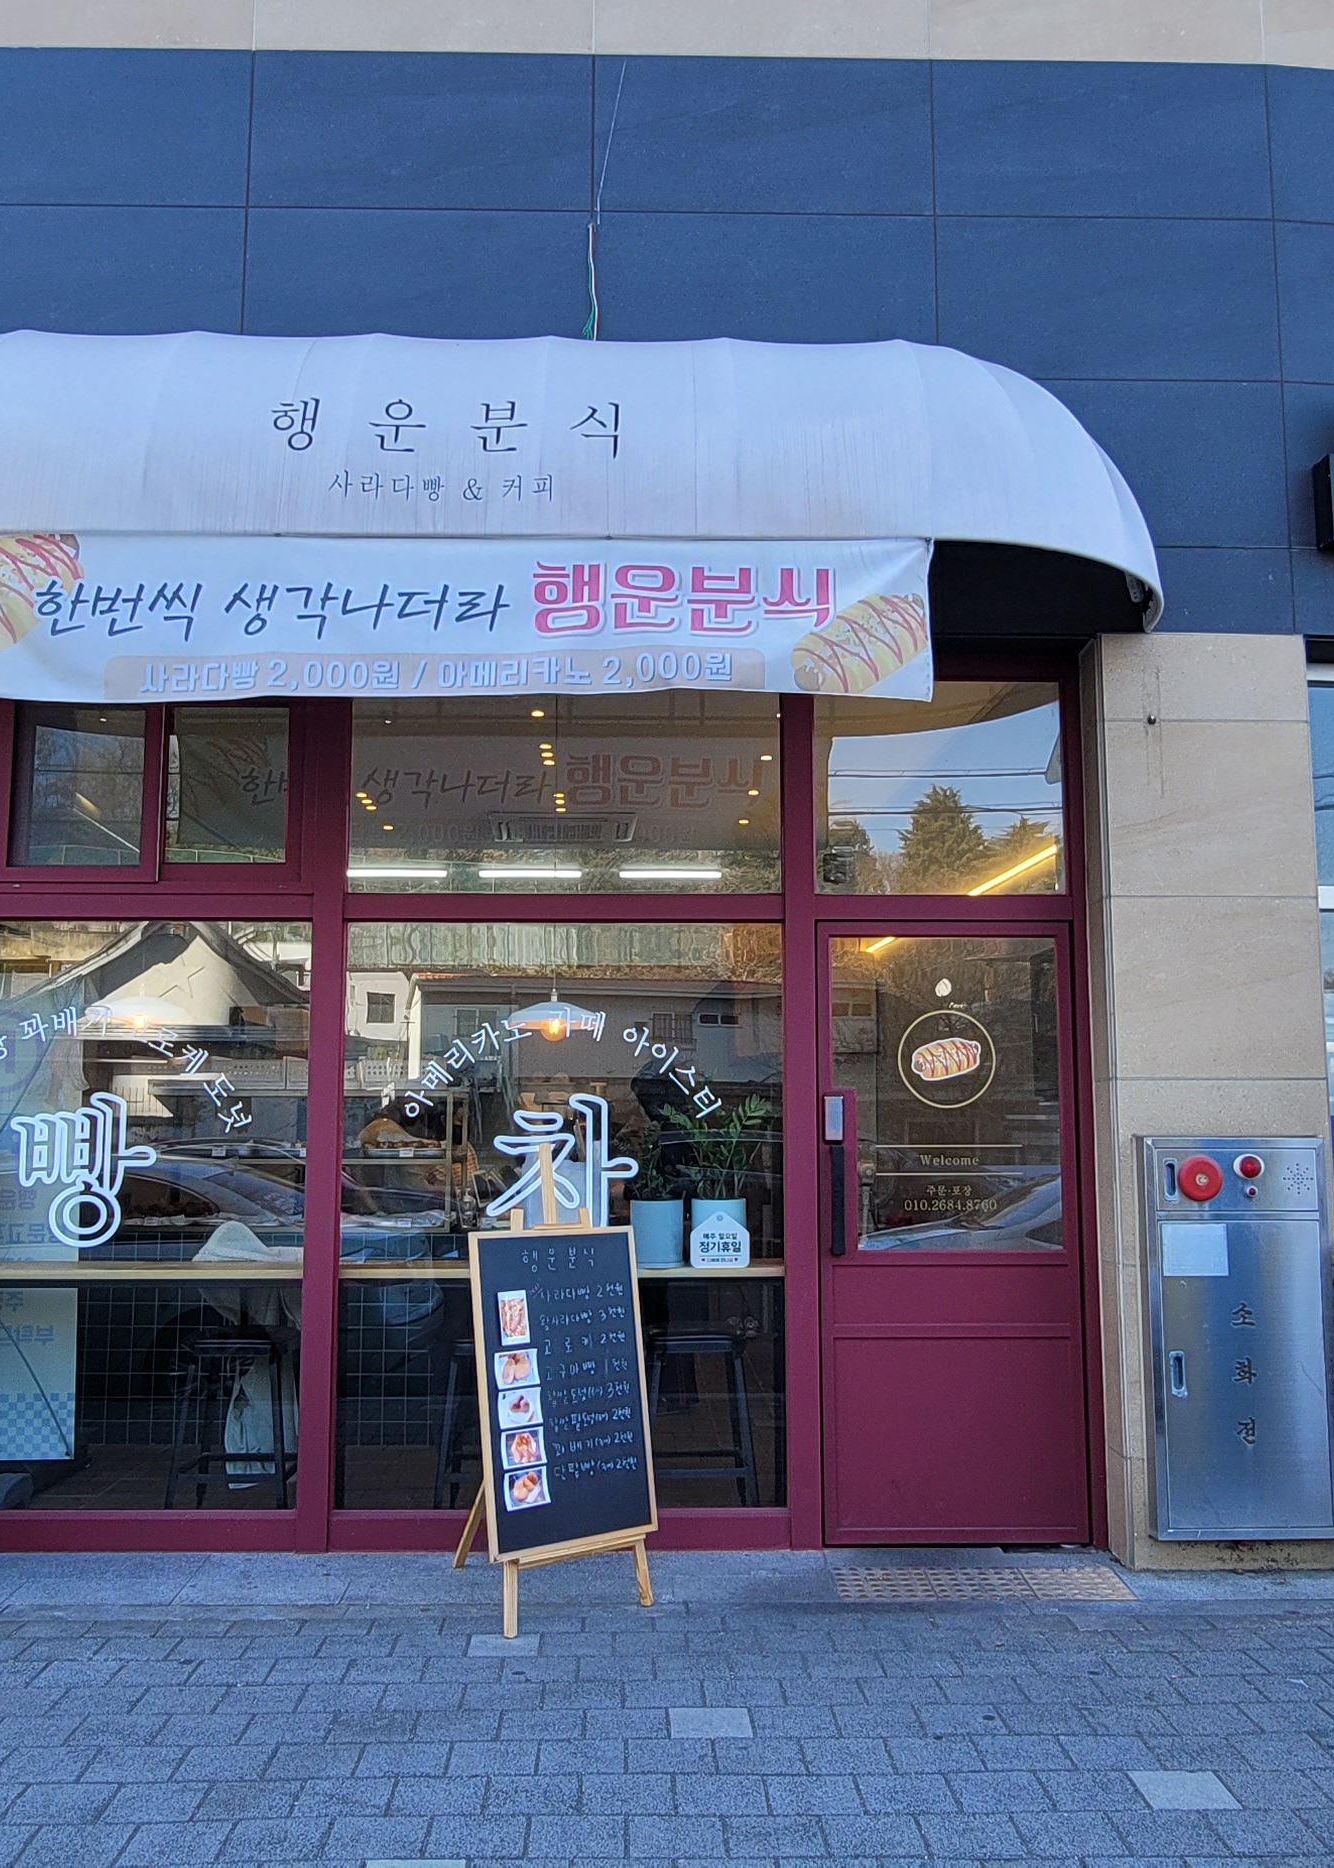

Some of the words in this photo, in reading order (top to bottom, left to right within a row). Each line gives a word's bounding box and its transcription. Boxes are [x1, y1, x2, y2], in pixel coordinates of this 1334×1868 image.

[327, 469, 445, 503] 사라다빵
[462, 477, 484, 502] &
[501, 473, 555, 503] 커피
[33, 577, 205, 643] 한번씩
[223, 580, 513, 641] 생각나더라
[531, 558, 839, 638] 행운분식
[139, 659, 260, 694] 사라다빵
[265, 657, 400, 692] 2,000원
[437, 656, 593, 690] 아메리카노
[601, 651, 734, 689] 2,000원
[403, 1020, 533, 1119] 아메리카노
[622, 1024, 722, 1120] 아이스티
[10, 1090, 158, 1249] 빵
[486, 1093, 640, 1228] 차
[919, 1153, 980, 1167] Welcome
[699, 1241, 742, 1253] 정기휴일
